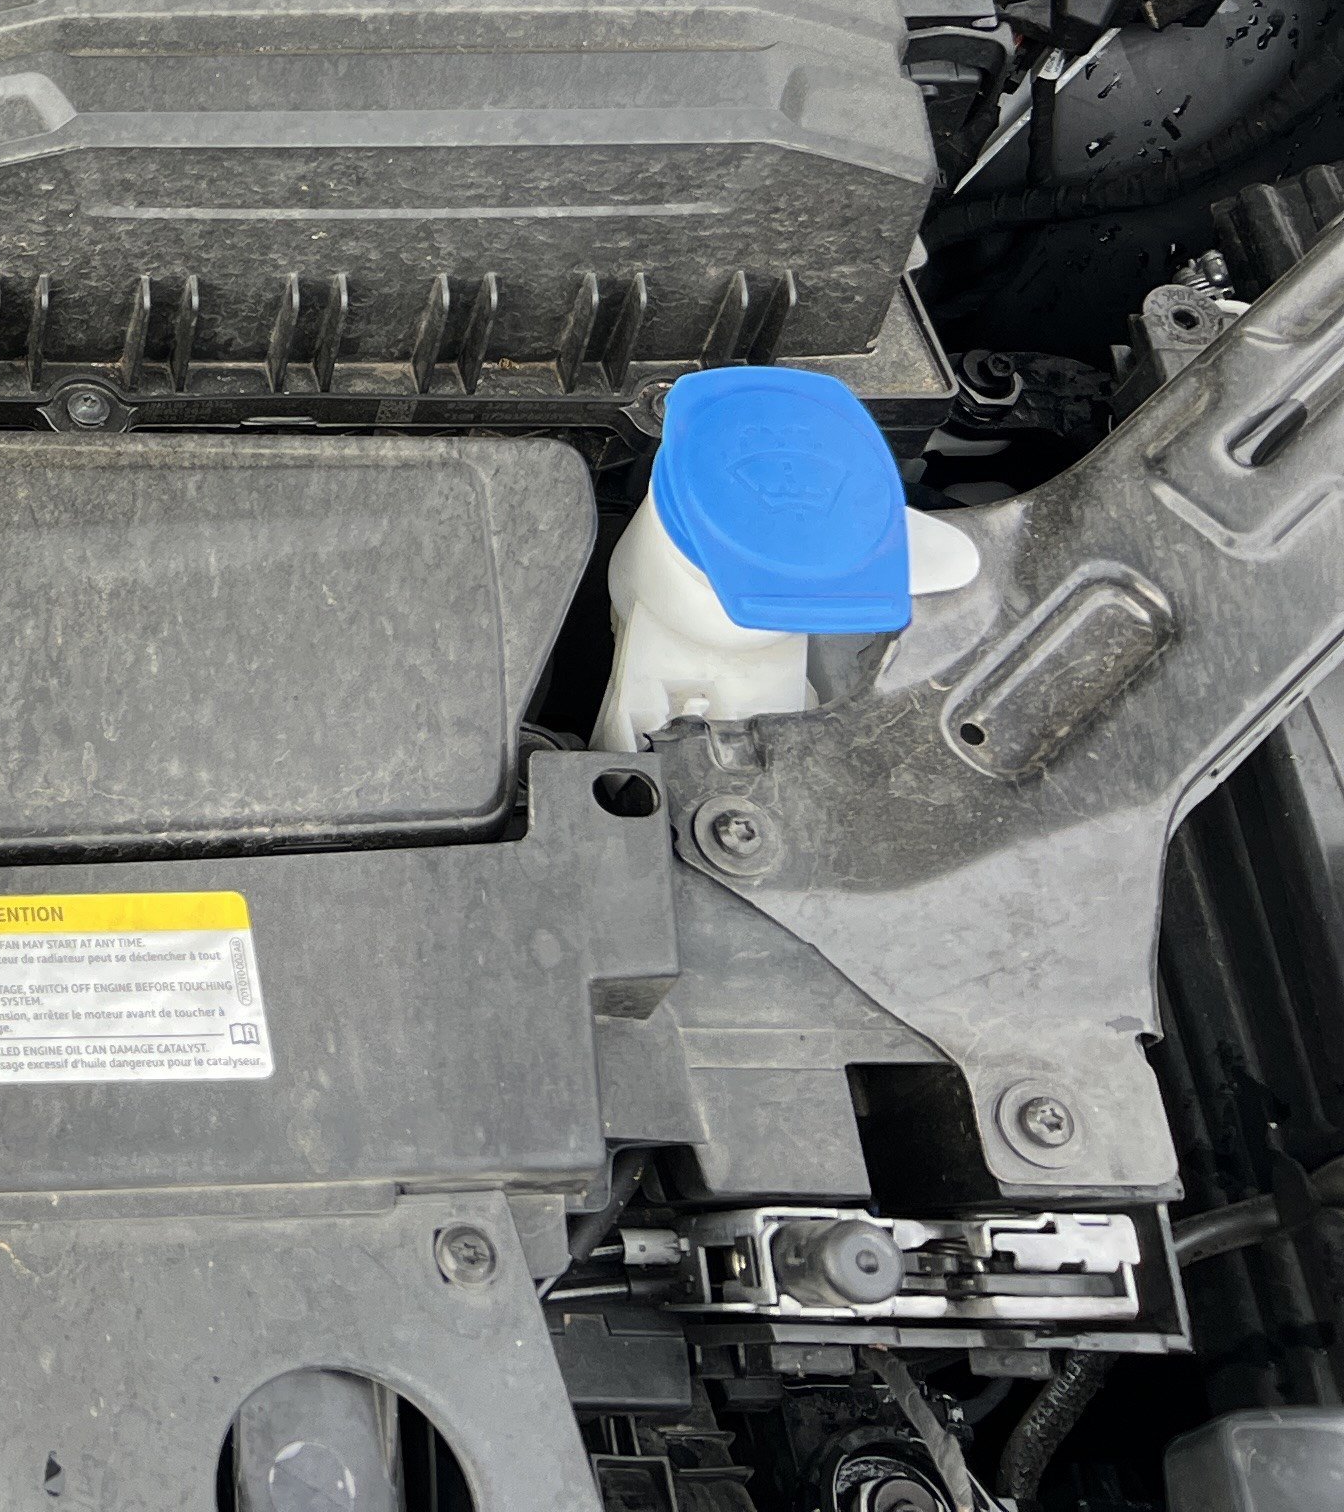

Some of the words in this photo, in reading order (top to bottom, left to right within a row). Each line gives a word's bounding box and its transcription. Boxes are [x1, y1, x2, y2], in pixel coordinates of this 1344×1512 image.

[21, 939, 44, 949] MAY
[45, 939, 78, 949] START
[78, 938, 93, 948] AT
[93, 938, 116, 948] ANY
[20, 954, 34, 964] de
[36, 953, 87, 963] radiateur
[87, 954, 113, 964] peut
[114, 954, 127, 962] se
[127, 951, 188, 962] déclencher
[197, 951, 222, 960] tout
[27, 983, 69, 994] SWITCH
[69, 983, 91, 993] OFF
[92, 982, 133, 993] ENGINE
[134, 981, 176, 992] BEFORE
[177, 980, 234, 991] TOUCHING
[71, 1009, 82, 1019] le
[83, 1010, 124, 1019] moteur
[125, 1009, 156, 1019] avant
[157, 1008, 173, 1018] de
[173, 1007, 216, 1018] toucher
[22, 1045, 64, 1056] ENGINE
[64, 1045, 82, 1056] OIL
[84, 1045, 107, 1055] CAN
[108, 1044, 155, 1055] DAMAGE
[25, 1058, 68, 1069] excessif
[69, 1057, 107, 1069] d'huile
[108, 1056, 165, 1070] dangereux
[166, 1058, 193, 1069] pour
[192, 1056, 204, 1067] le
